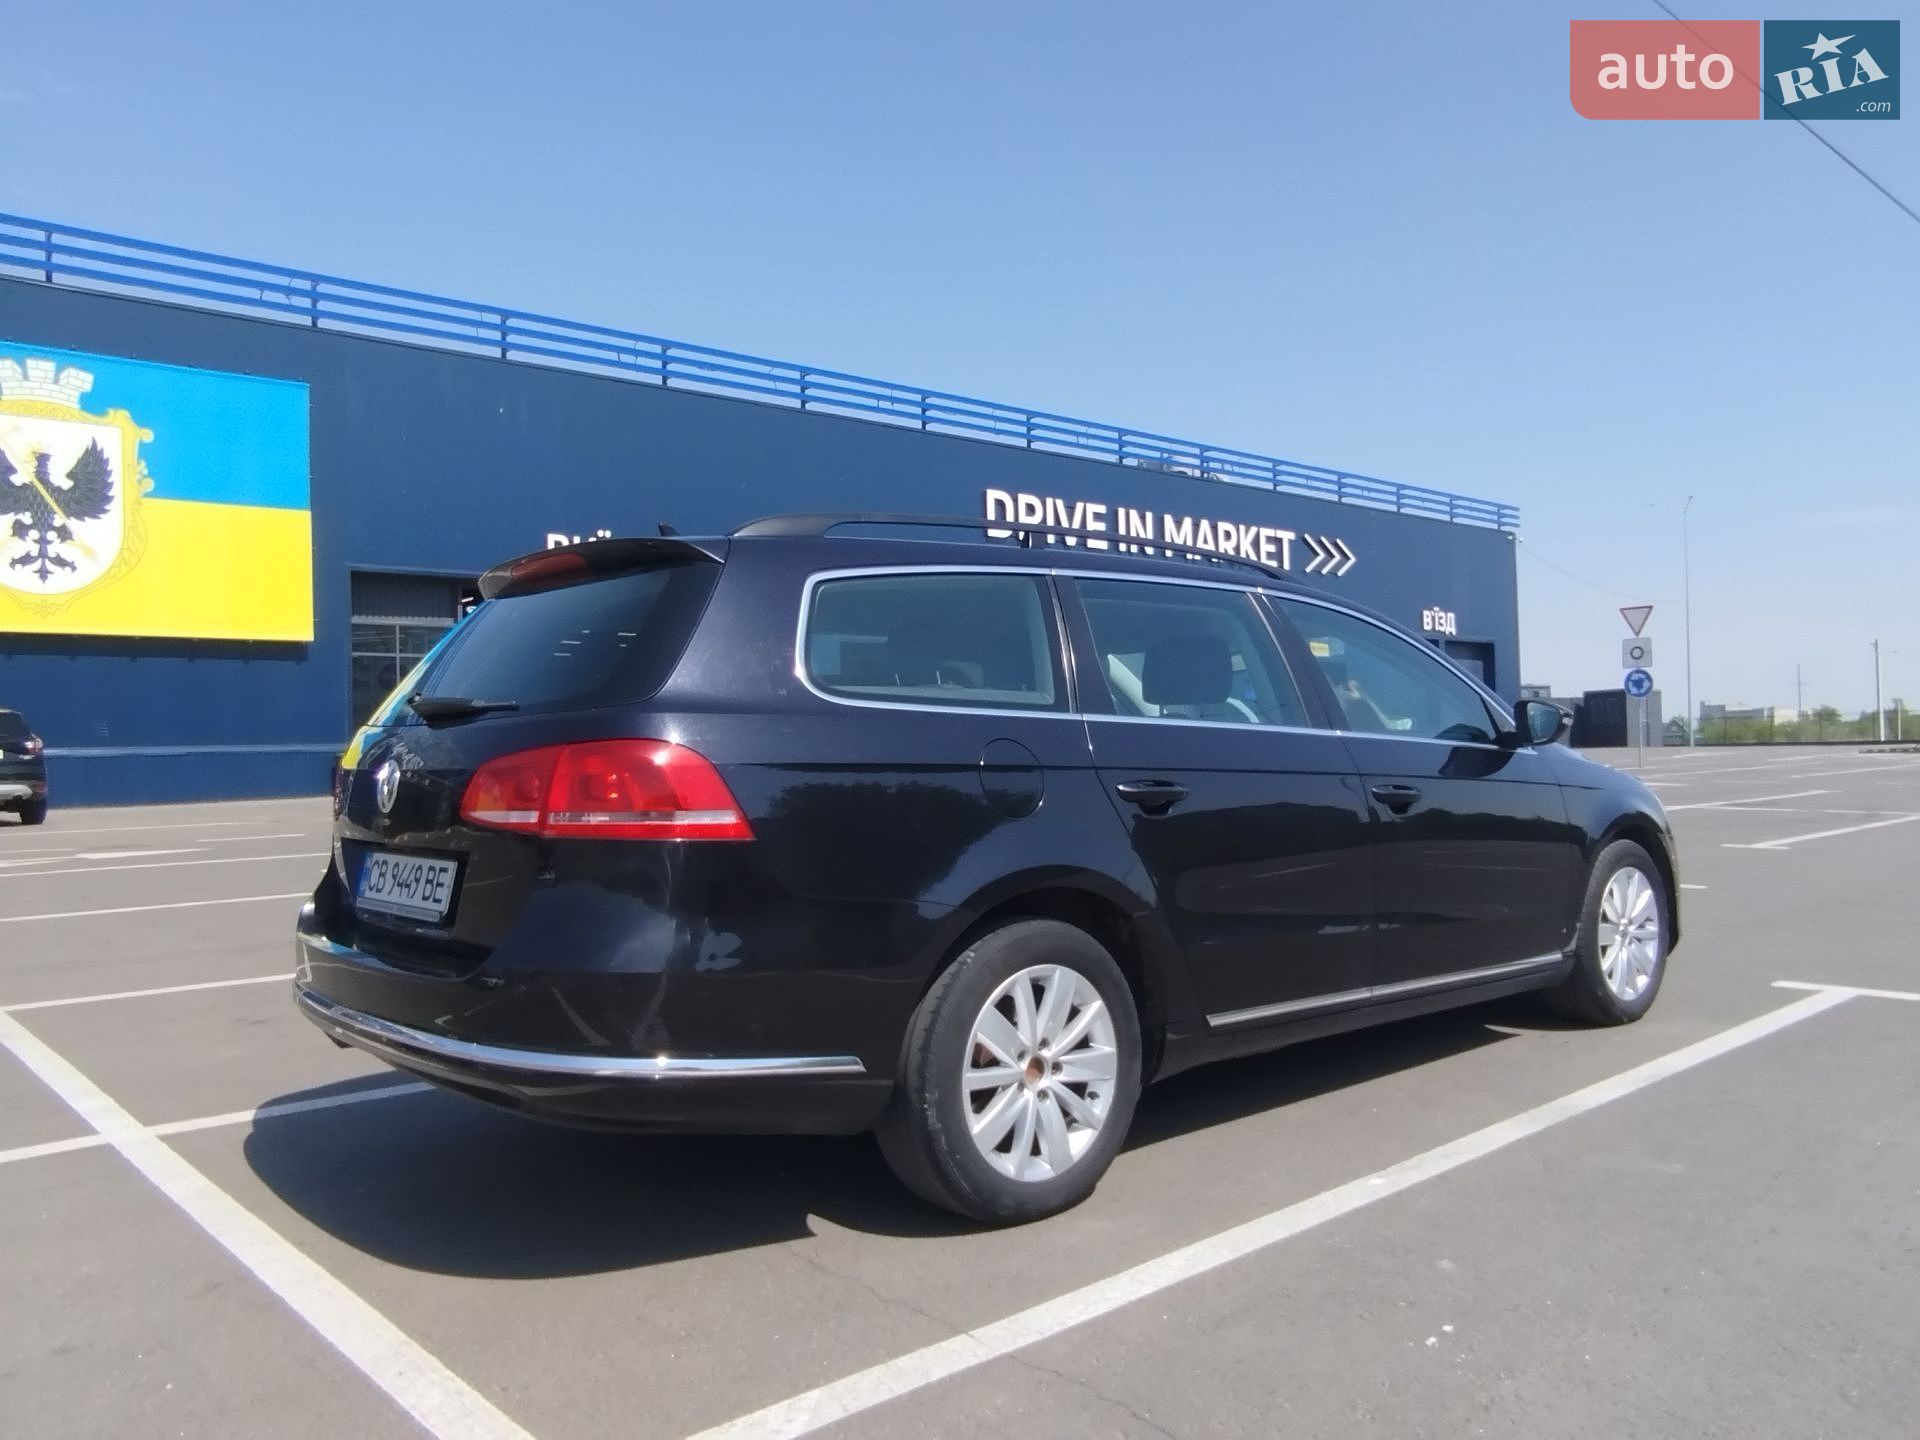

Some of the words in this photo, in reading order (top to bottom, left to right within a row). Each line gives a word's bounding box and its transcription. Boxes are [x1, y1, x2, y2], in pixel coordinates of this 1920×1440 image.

[985, 488, 1109, 550] DRIVE
[1116, 507, 1154, 556] IN
[1163, 513, 1296, 571] MARKET
[367, 859, 389, 894] CB
[387, 861, 423, 899] 9449
[421, 865, 450, 904] BE
